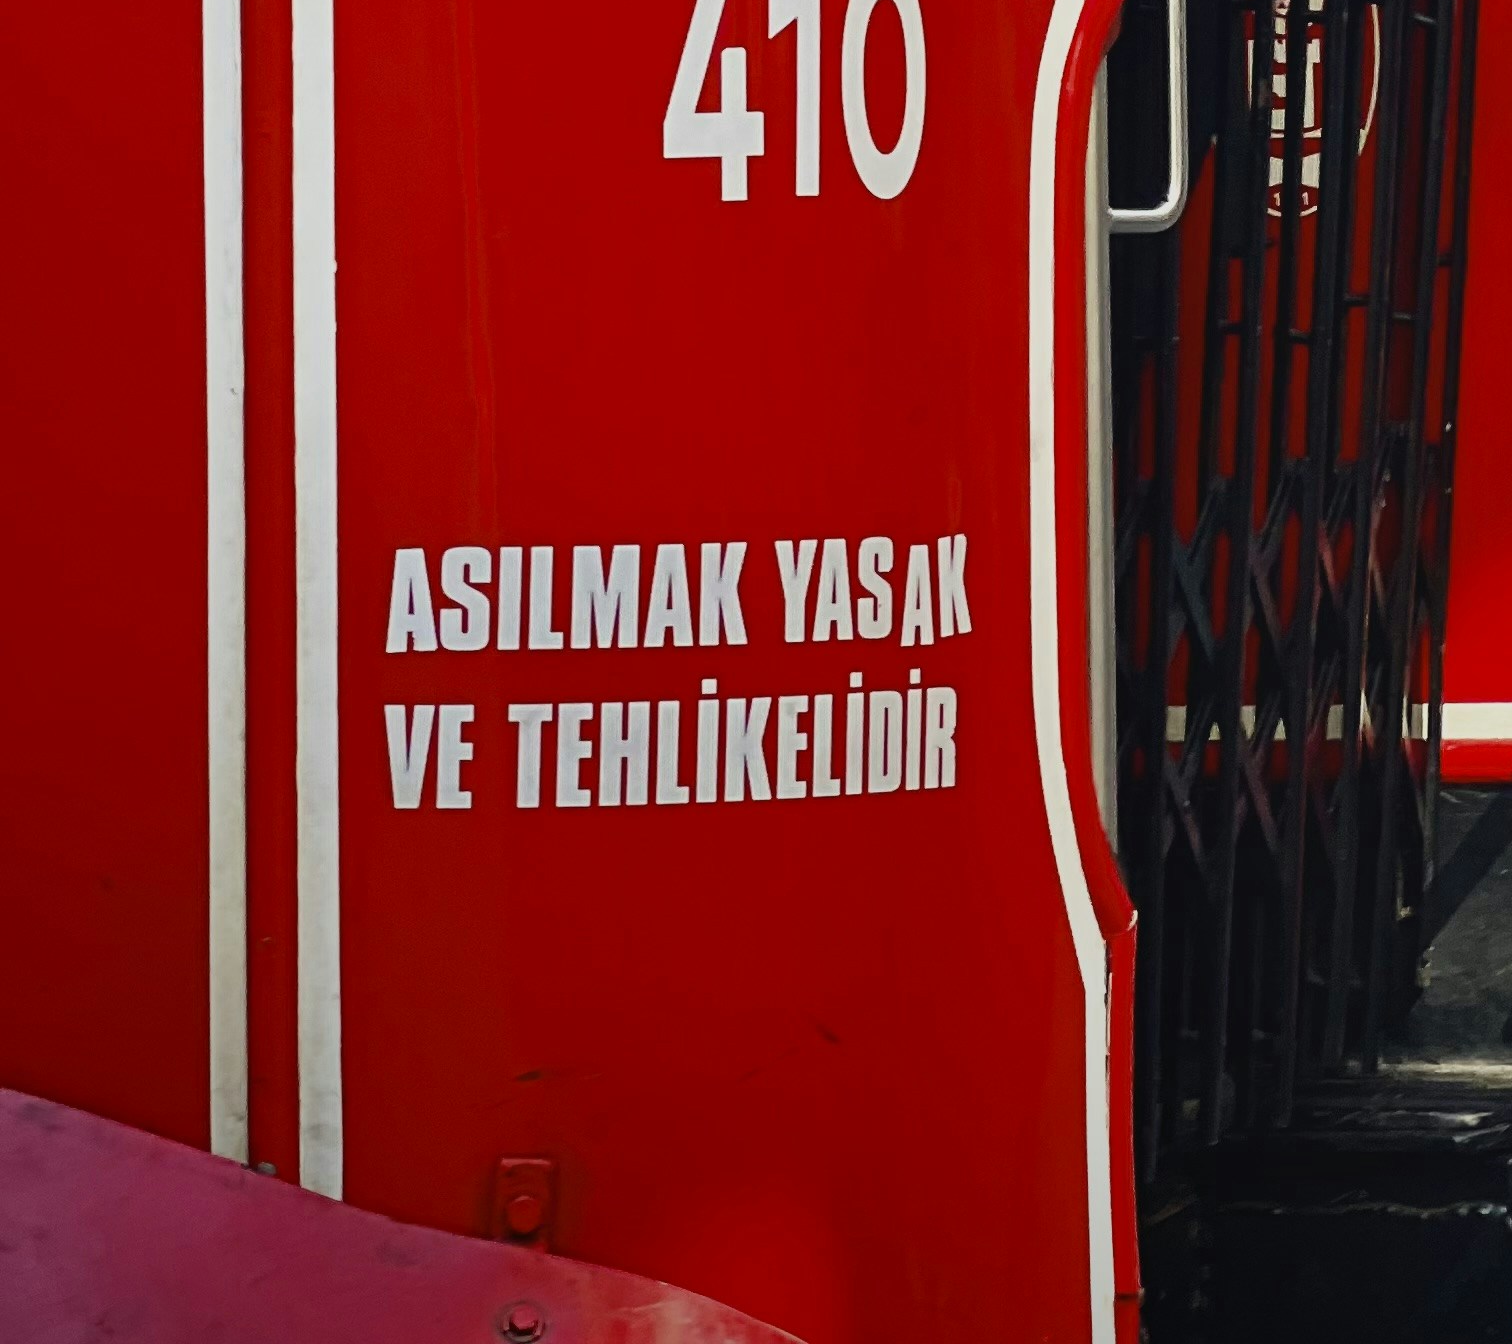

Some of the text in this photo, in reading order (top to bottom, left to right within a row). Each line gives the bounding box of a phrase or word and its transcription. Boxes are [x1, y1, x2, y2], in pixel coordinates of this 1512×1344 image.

[385, 533, 973, 654] ASILMAK YASAK
[384, 667, 958, 810] VE TEHLİKELİDİR
